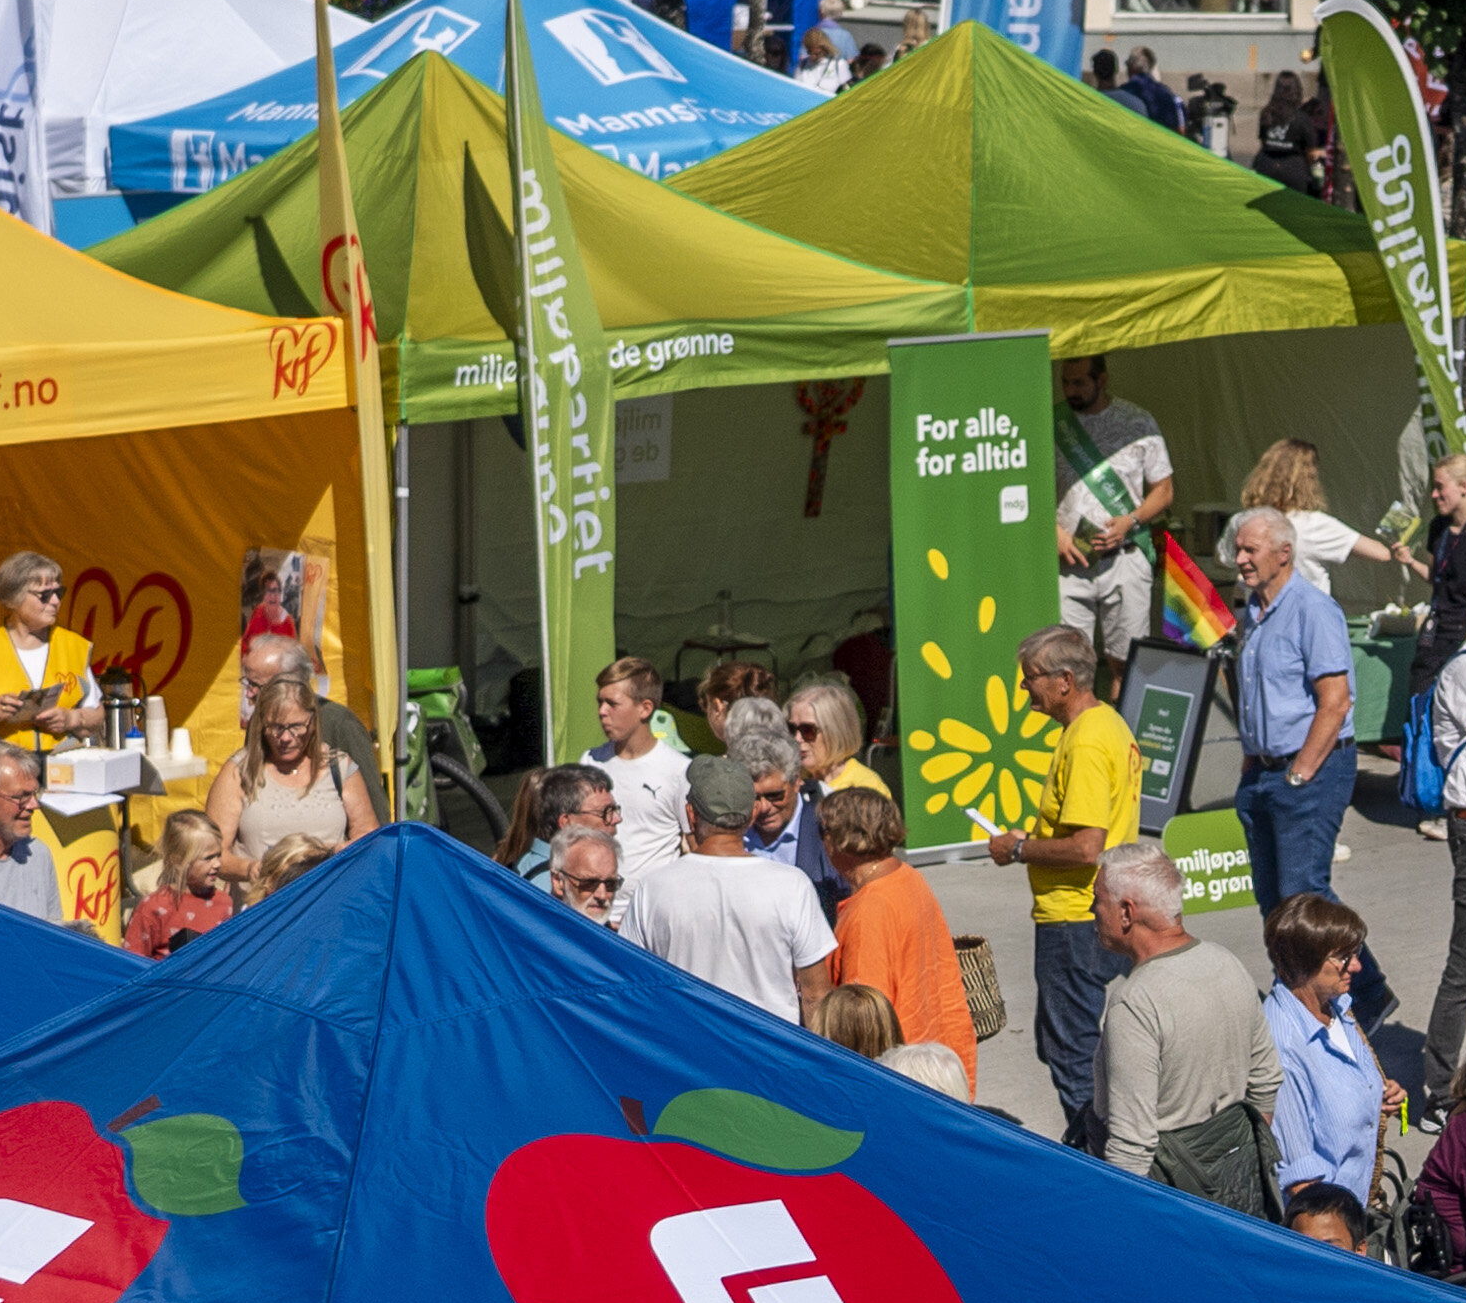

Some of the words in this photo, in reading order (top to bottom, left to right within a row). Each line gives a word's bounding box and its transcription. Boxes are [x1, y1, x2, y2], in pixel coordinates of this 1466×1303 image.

[555, 96, 794, 138] MannsForum
[609, 339, 641, 370] de
[645, 332, 735, 372] grønne
[916, 413, 960, 443] For
[965, 406, 1020, 439] alle,
[916, 446, 957, 478] for
[961, 438, 1028, 474] alltid
[1175, 848, 1251, 876] miljøpa
